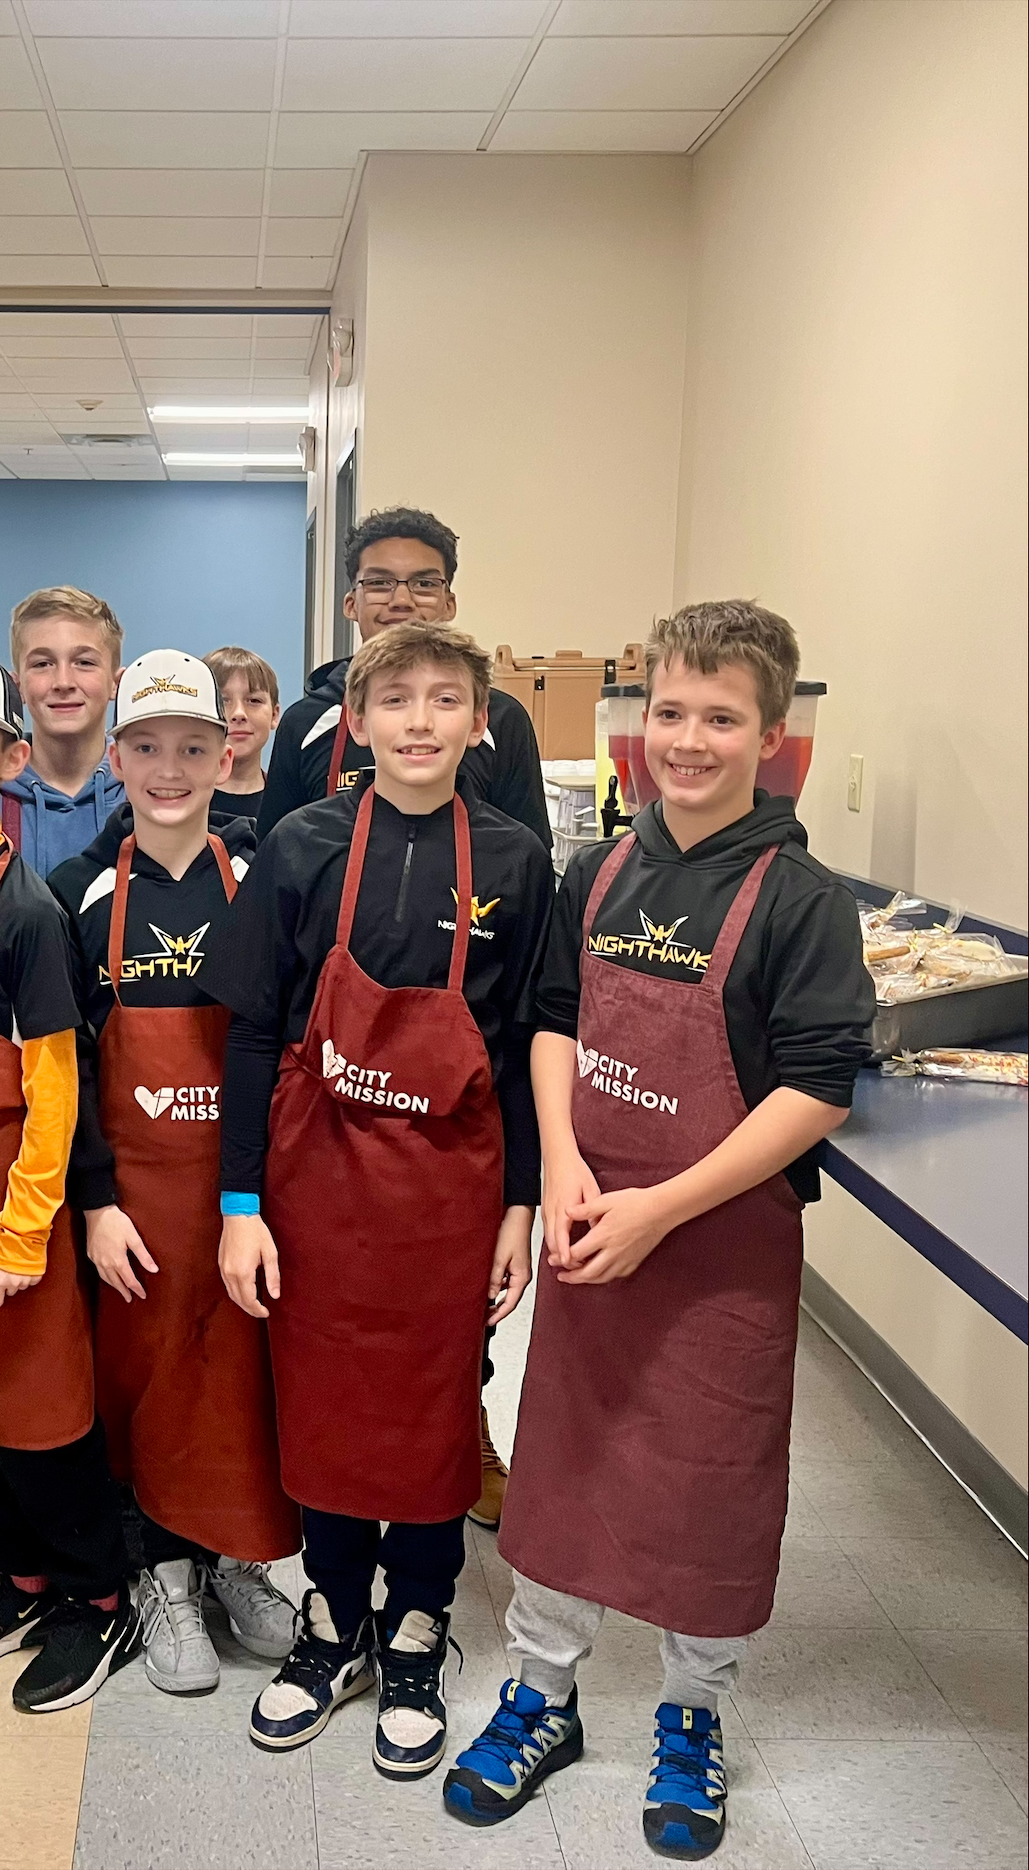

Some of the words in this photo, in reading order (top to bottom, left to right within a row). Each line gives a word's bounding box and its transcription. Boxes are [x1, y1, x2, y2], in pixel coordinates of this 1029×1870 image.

[346, 1064, 392, 1088] CITY
[598, 1055, 639, 1082] CITY
[176, 1086, 220, 1103] CITY
[334, 1076, 430, 1114] MISSION
[591, 1071, 678, 1115] MISSION
